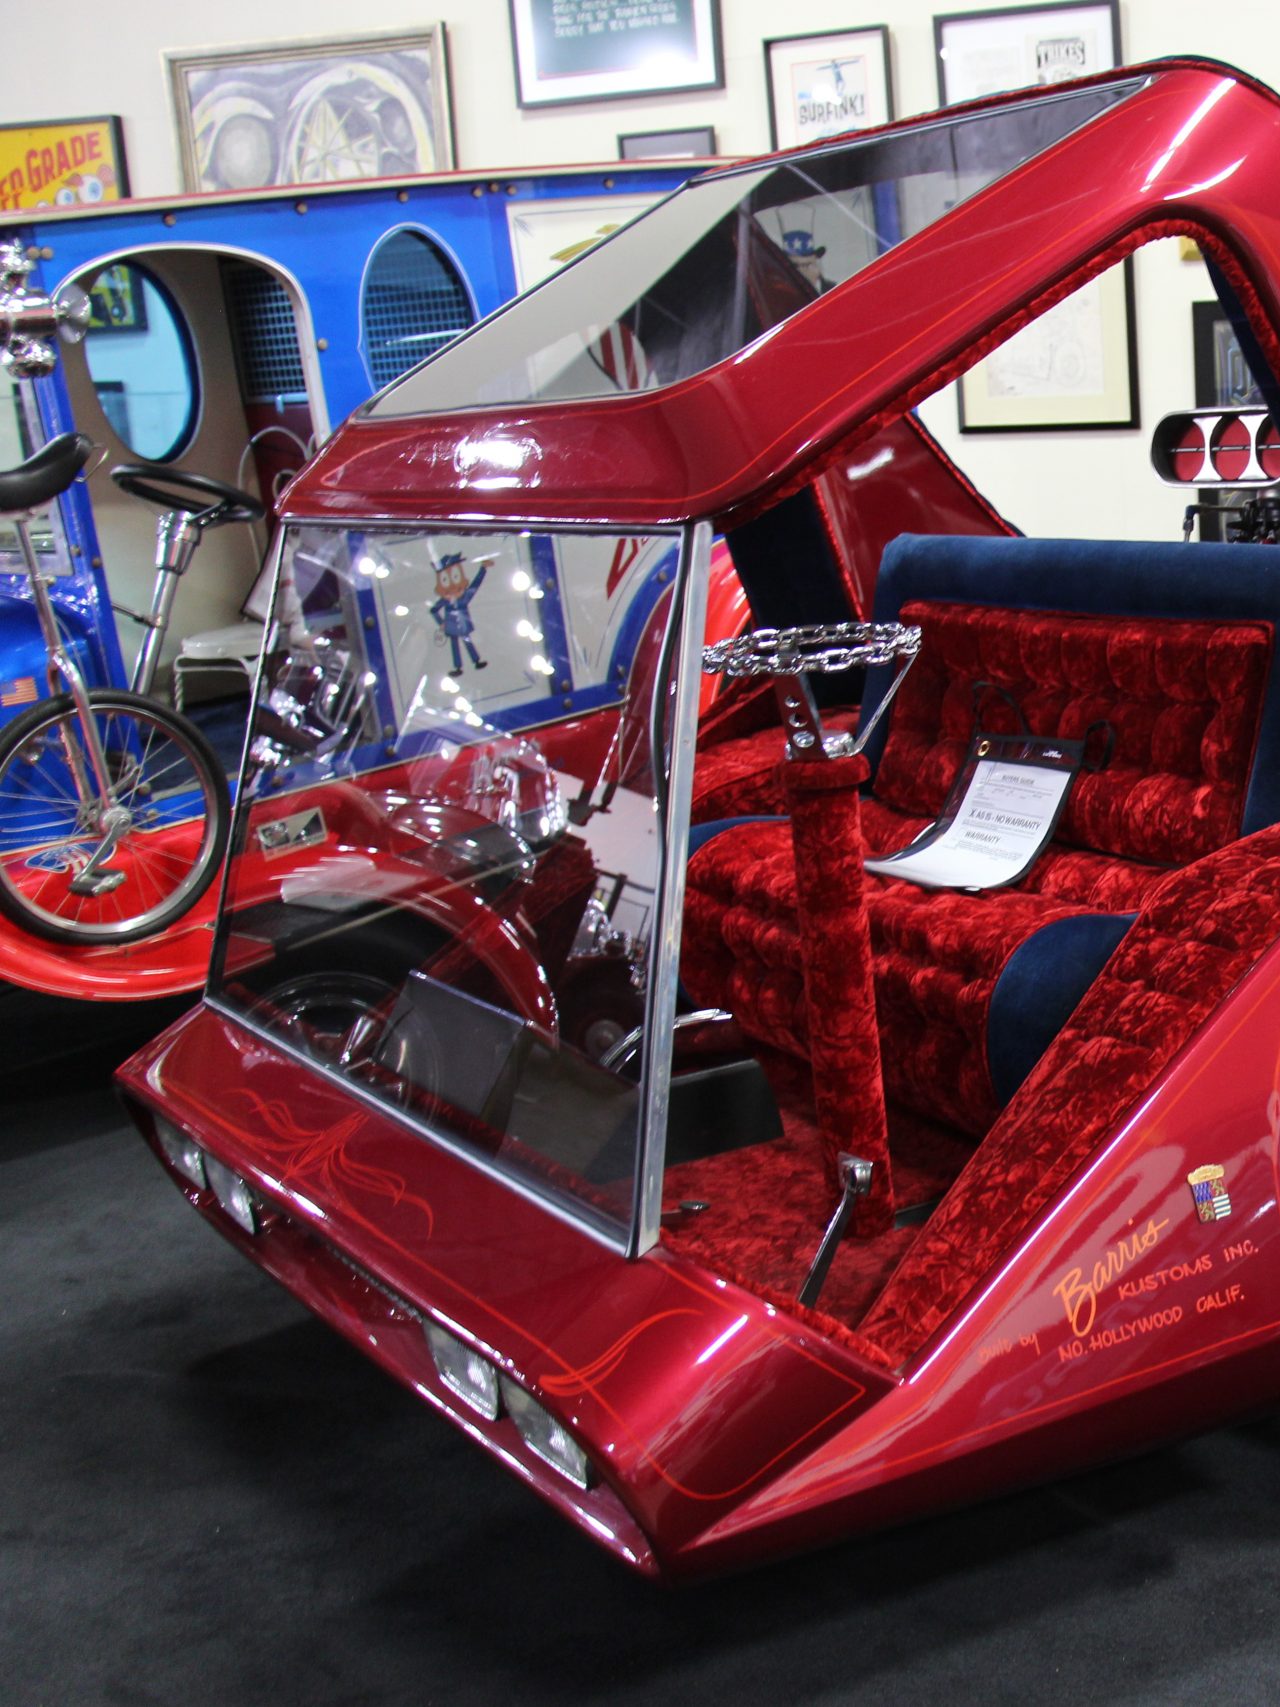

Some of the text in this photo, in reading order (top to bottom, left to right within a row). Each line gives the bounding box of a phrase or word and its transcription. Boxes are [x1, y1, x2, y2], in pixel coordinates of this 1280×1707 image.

[25, 131, 102, 192] GRADE
[964, 831, 1001, 844] WARRANTY
[995, 815, 1005, 823] NO
[1005, 816, 1041, 830] WARRANTY
[1053, 1218, 1169, 1337] Barris
[1119, 1240, 1259, 1300] KUSTOMS INC.
[1020, 1333, 1041, 1356] by
[1090, 1306, 1183, 1351] HOLLYWOOD
[1196, 1284, 1245, 1313] CALIF.
